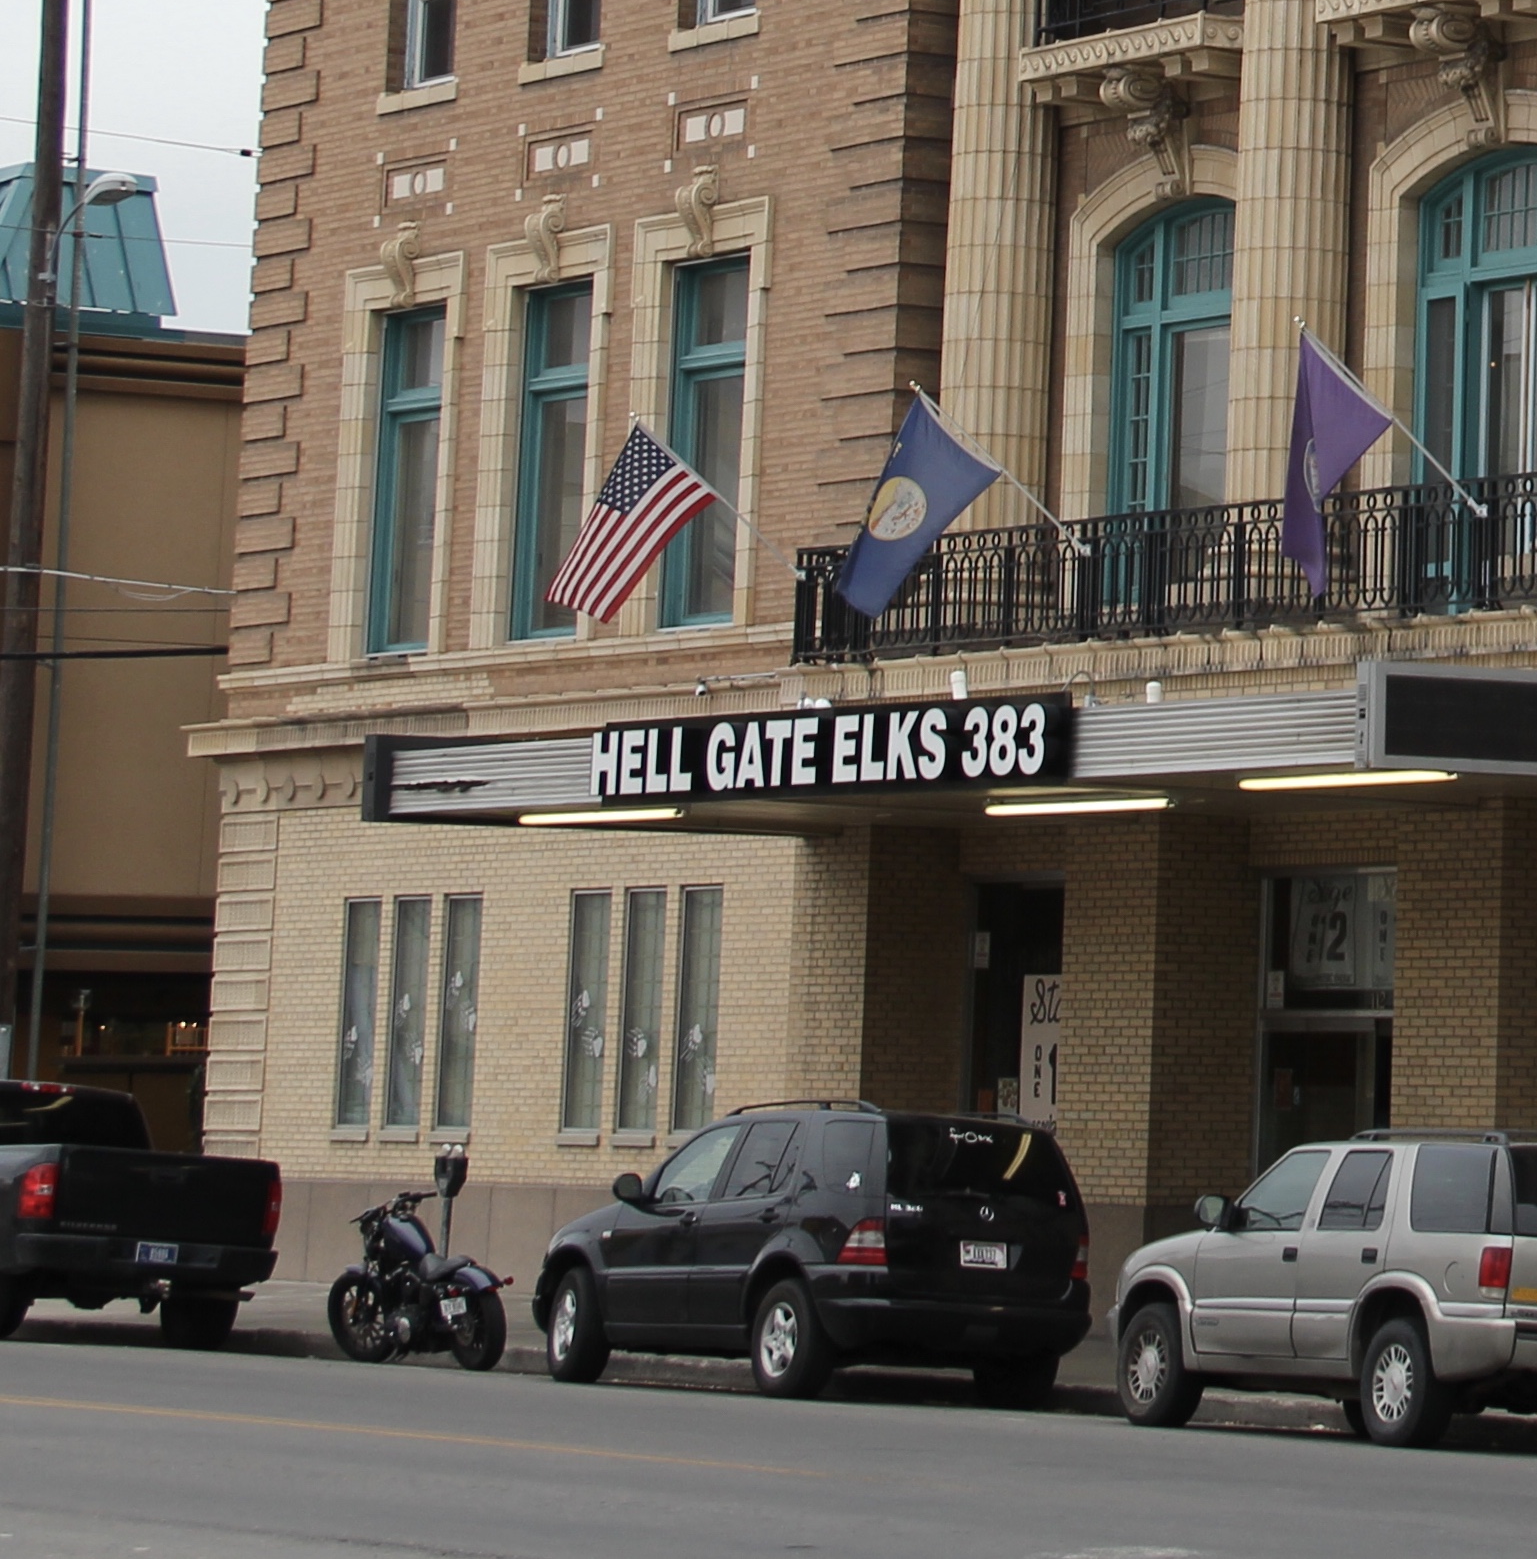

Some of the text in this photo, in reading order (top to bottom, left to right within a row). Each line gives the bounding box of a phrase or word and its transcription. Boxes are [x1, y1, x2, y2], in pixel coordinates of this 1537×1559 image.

[590, 701, 1047, 797] HELL GATE ELKS 383
